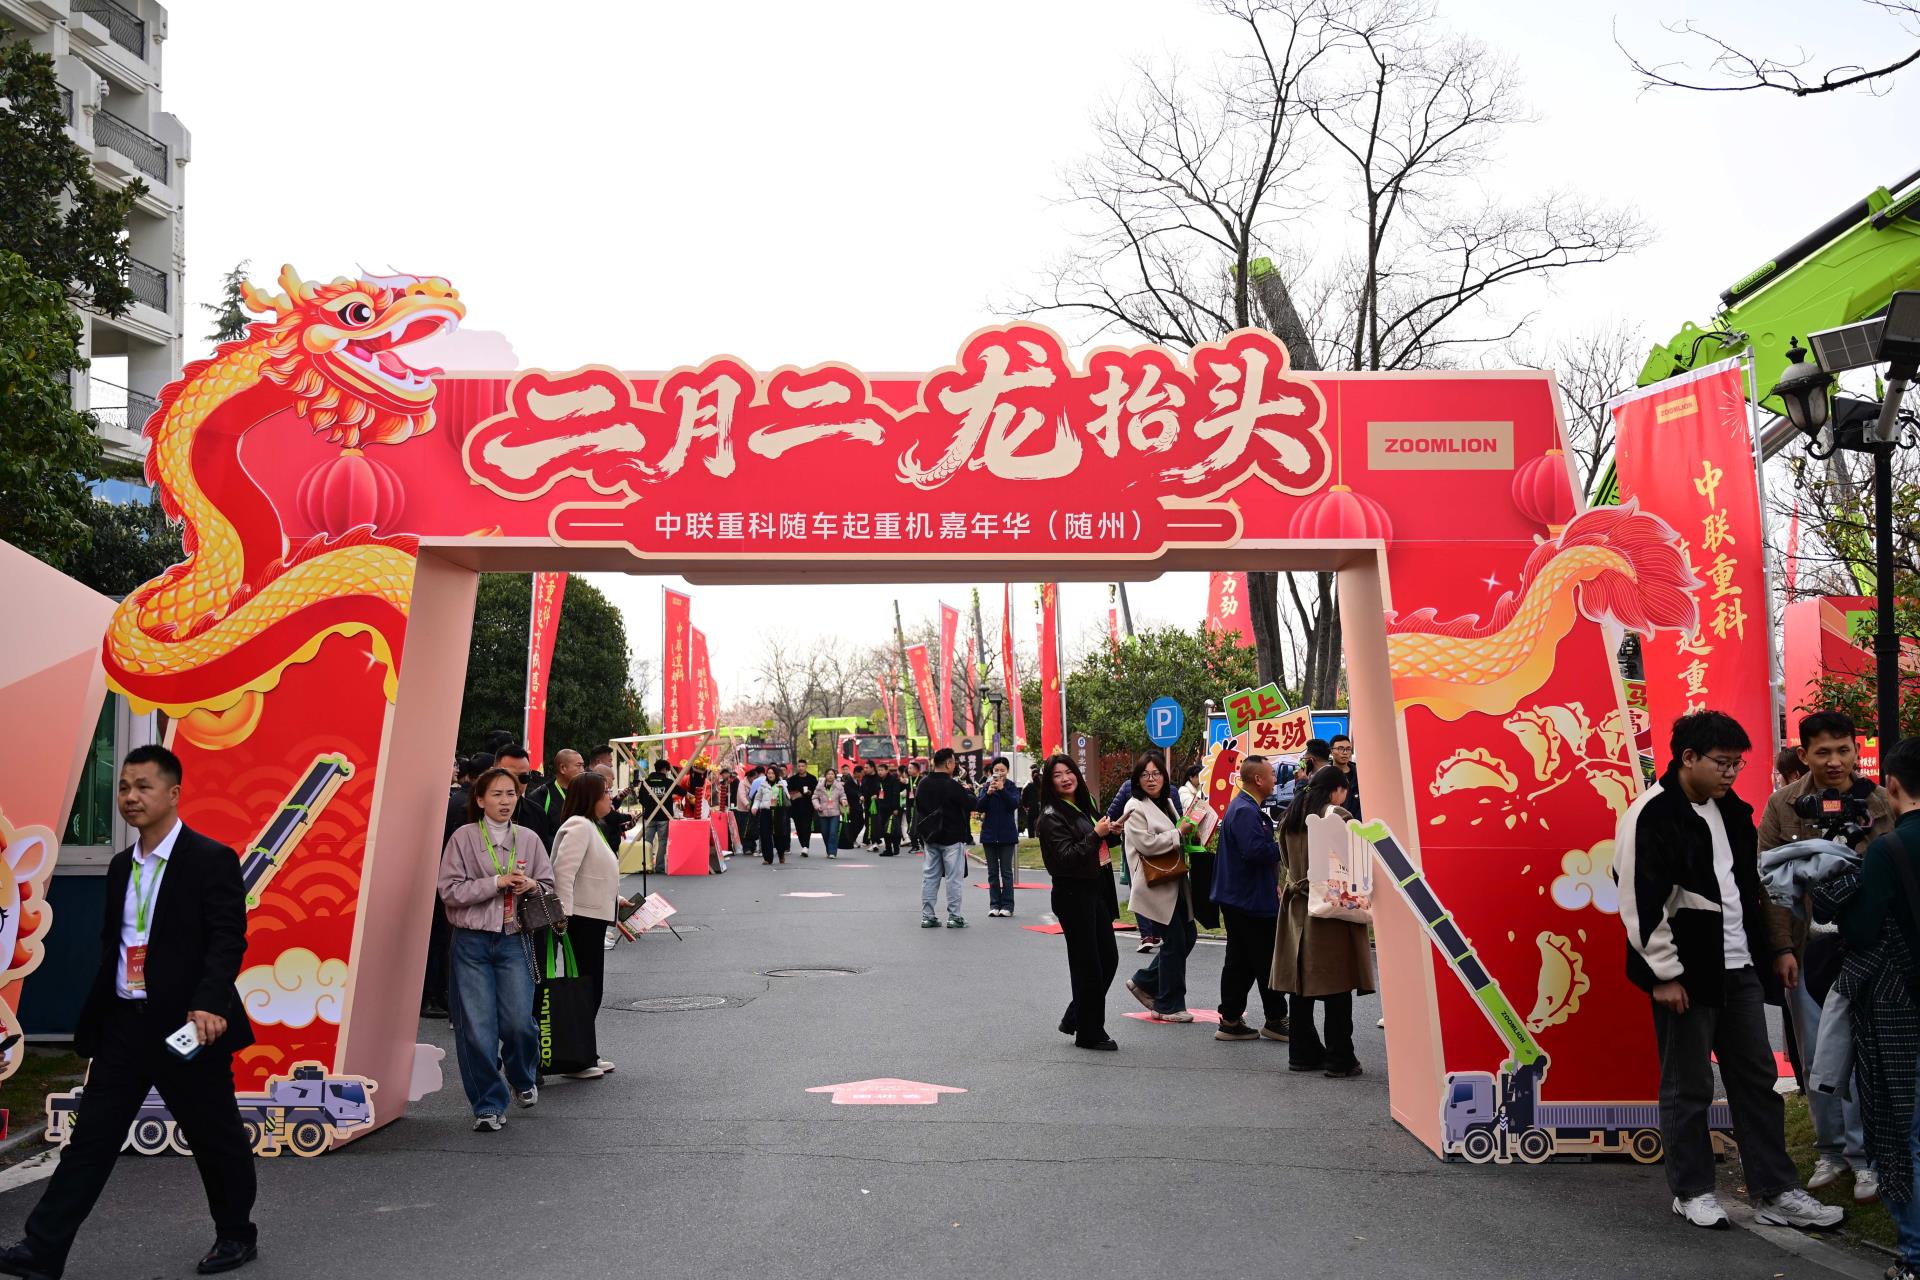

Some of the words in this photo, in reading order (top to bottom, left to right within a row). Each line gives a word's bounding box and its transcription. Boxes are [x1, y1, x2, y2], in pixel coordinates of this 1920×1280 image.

[483, 341, 1310, 490] 二月二龙抬头
[1660, 401, 1693, 418] ZOOMLION
[1384, 437, 1498, 454] ZOOMLION
[654, 510, 1142, 542] 中联重科随车起重机嘉年华（随州）
[1693, 459, 1746, 642] 中联重科
[1219, 571, 1239, 619] 力劲
[1156, 709, 1172, 737] P
[1230, 694, 1281, 729] 马上
[1254, 717, 1307, 751] 发财
[1502, 1011, 1525, 1043] ZOOMLION
